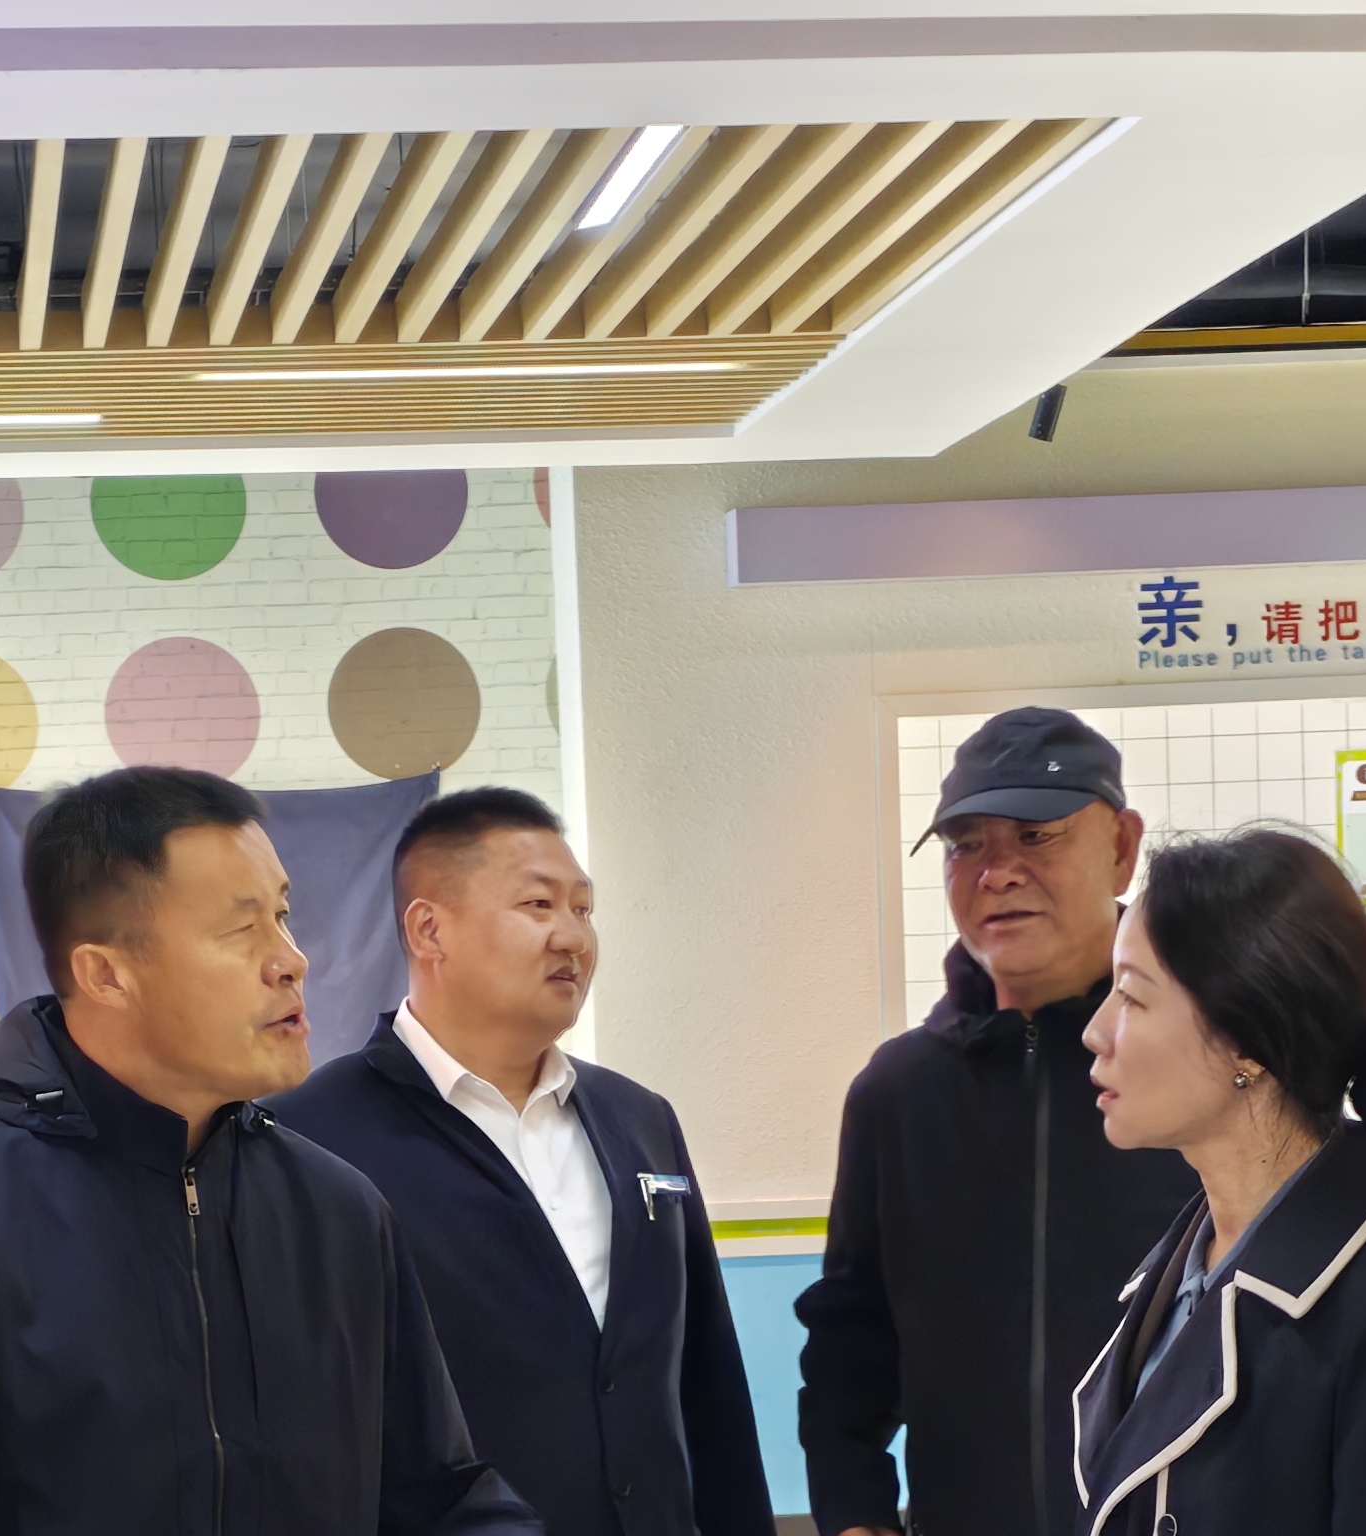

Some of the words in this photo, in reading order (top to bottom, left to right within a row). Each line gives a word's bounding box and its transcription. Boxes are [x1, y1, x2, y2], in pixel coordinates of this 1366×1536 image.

[1138, 651, 1219, 669] Please
[1233, 648, 1272, 670] put
[1288, 645, 1328, 663] the
